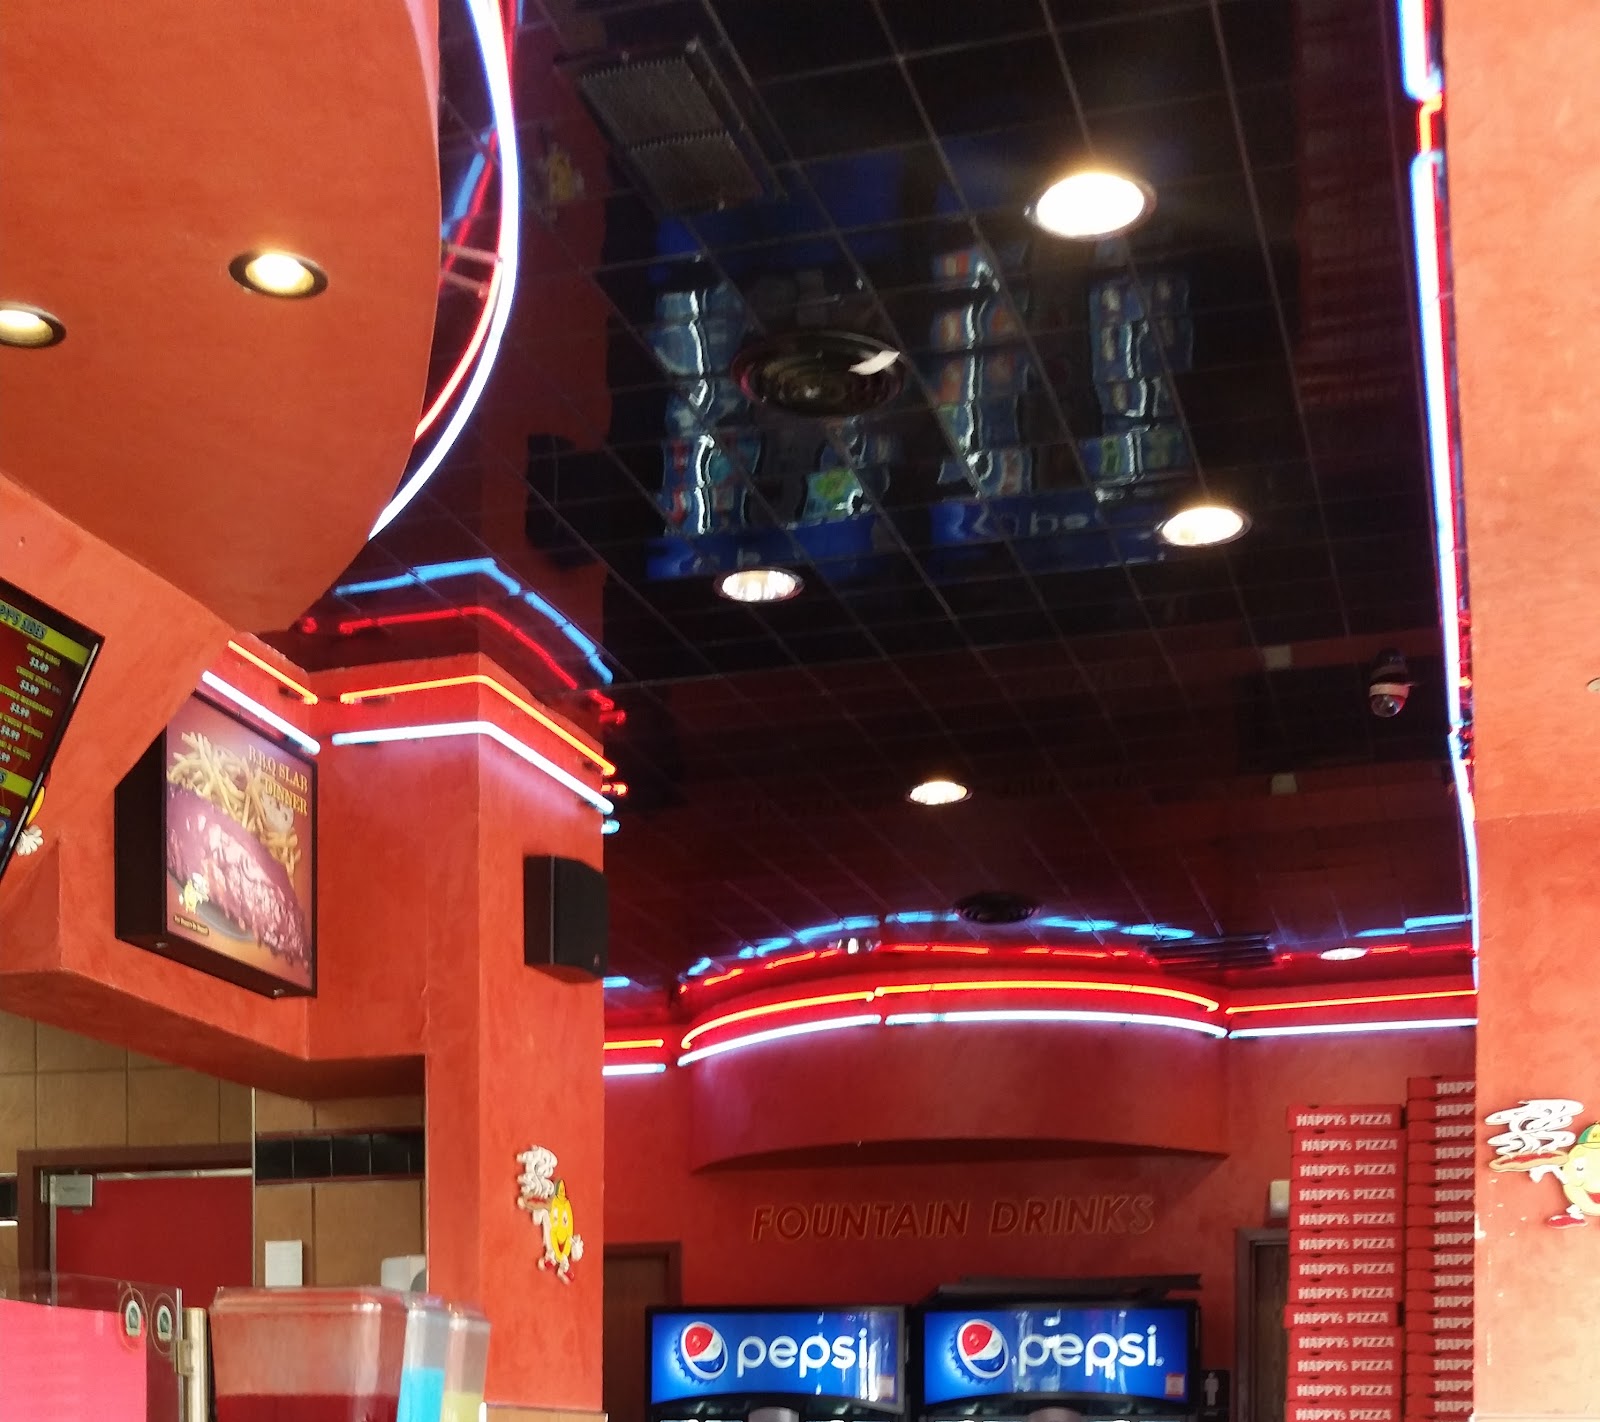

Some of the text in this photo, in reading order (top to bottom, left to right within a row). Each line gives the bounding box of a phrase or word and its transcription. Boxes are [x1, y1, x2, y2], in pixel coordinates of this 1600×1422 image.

[279, 762, 309, 795] SLAB
[264, 778, 308, 817] DINNER
[1437, 1081, 1475, 1094] HAPP
[1436, 1104, 1475, 1117] HAPP
[1350, 1112, 1392, 1125] PIZZA
[1436, 1125, 1475, 1138] HAPP
[1355, 1138, 1398, 1150] PIZZA
[1436, 1146, 1475, 1159] HAPP
[1354, 1163, 1396, 1175] PIZZA
[1435, 1168, 1475, 1180] HAPP
[1353, 1188, 1396, 1200] PIZZA
[1435, 1189, 1475, 1201] HAPP
[752, 1193, 1156, 1242] FOUNTAIN DRINKS
[1353, 1212, 1396, 1224] PIZZA
[1434, 1211, 1474, 1223] HAPP
[1353, 1238, 1395, 1249] PIZZA
[1434, 1233, 1474, 1245] HAPP
[1433, 1254, 1474, 1266] HAPP
[1353, 1263, 1395, 1274] PIZZA
[1434, 1275, 1474, 1287] HAPP
[1352, 1287, 1394, 1298] PIZZA
[1433, 1296, 1474, 1308] HAPP
[1347, 1311, 1389, 1323] PIZZA
[1433, 1317, 1473, 1329] HAPP
[1353, 1336, 1395, 1347] PIZZA
[1434, 1338, 1473, 1350] HAPP
[737, 1328, 867, 1378] pepsi
[1018, 1324, 1158, 1377] pepsi
[1351, 1359, 1393, 1371] PIZZA
[1433, 1359, 1473, 1371] HAPP
[1351, 1384, 1393, 1396] PIZZA
[1435, 1380, 1473, 1392] HAPP
[1434, 1401, 1473, 1412] HAPP
[1349, 1409, 1392, 1421] PIZZA
